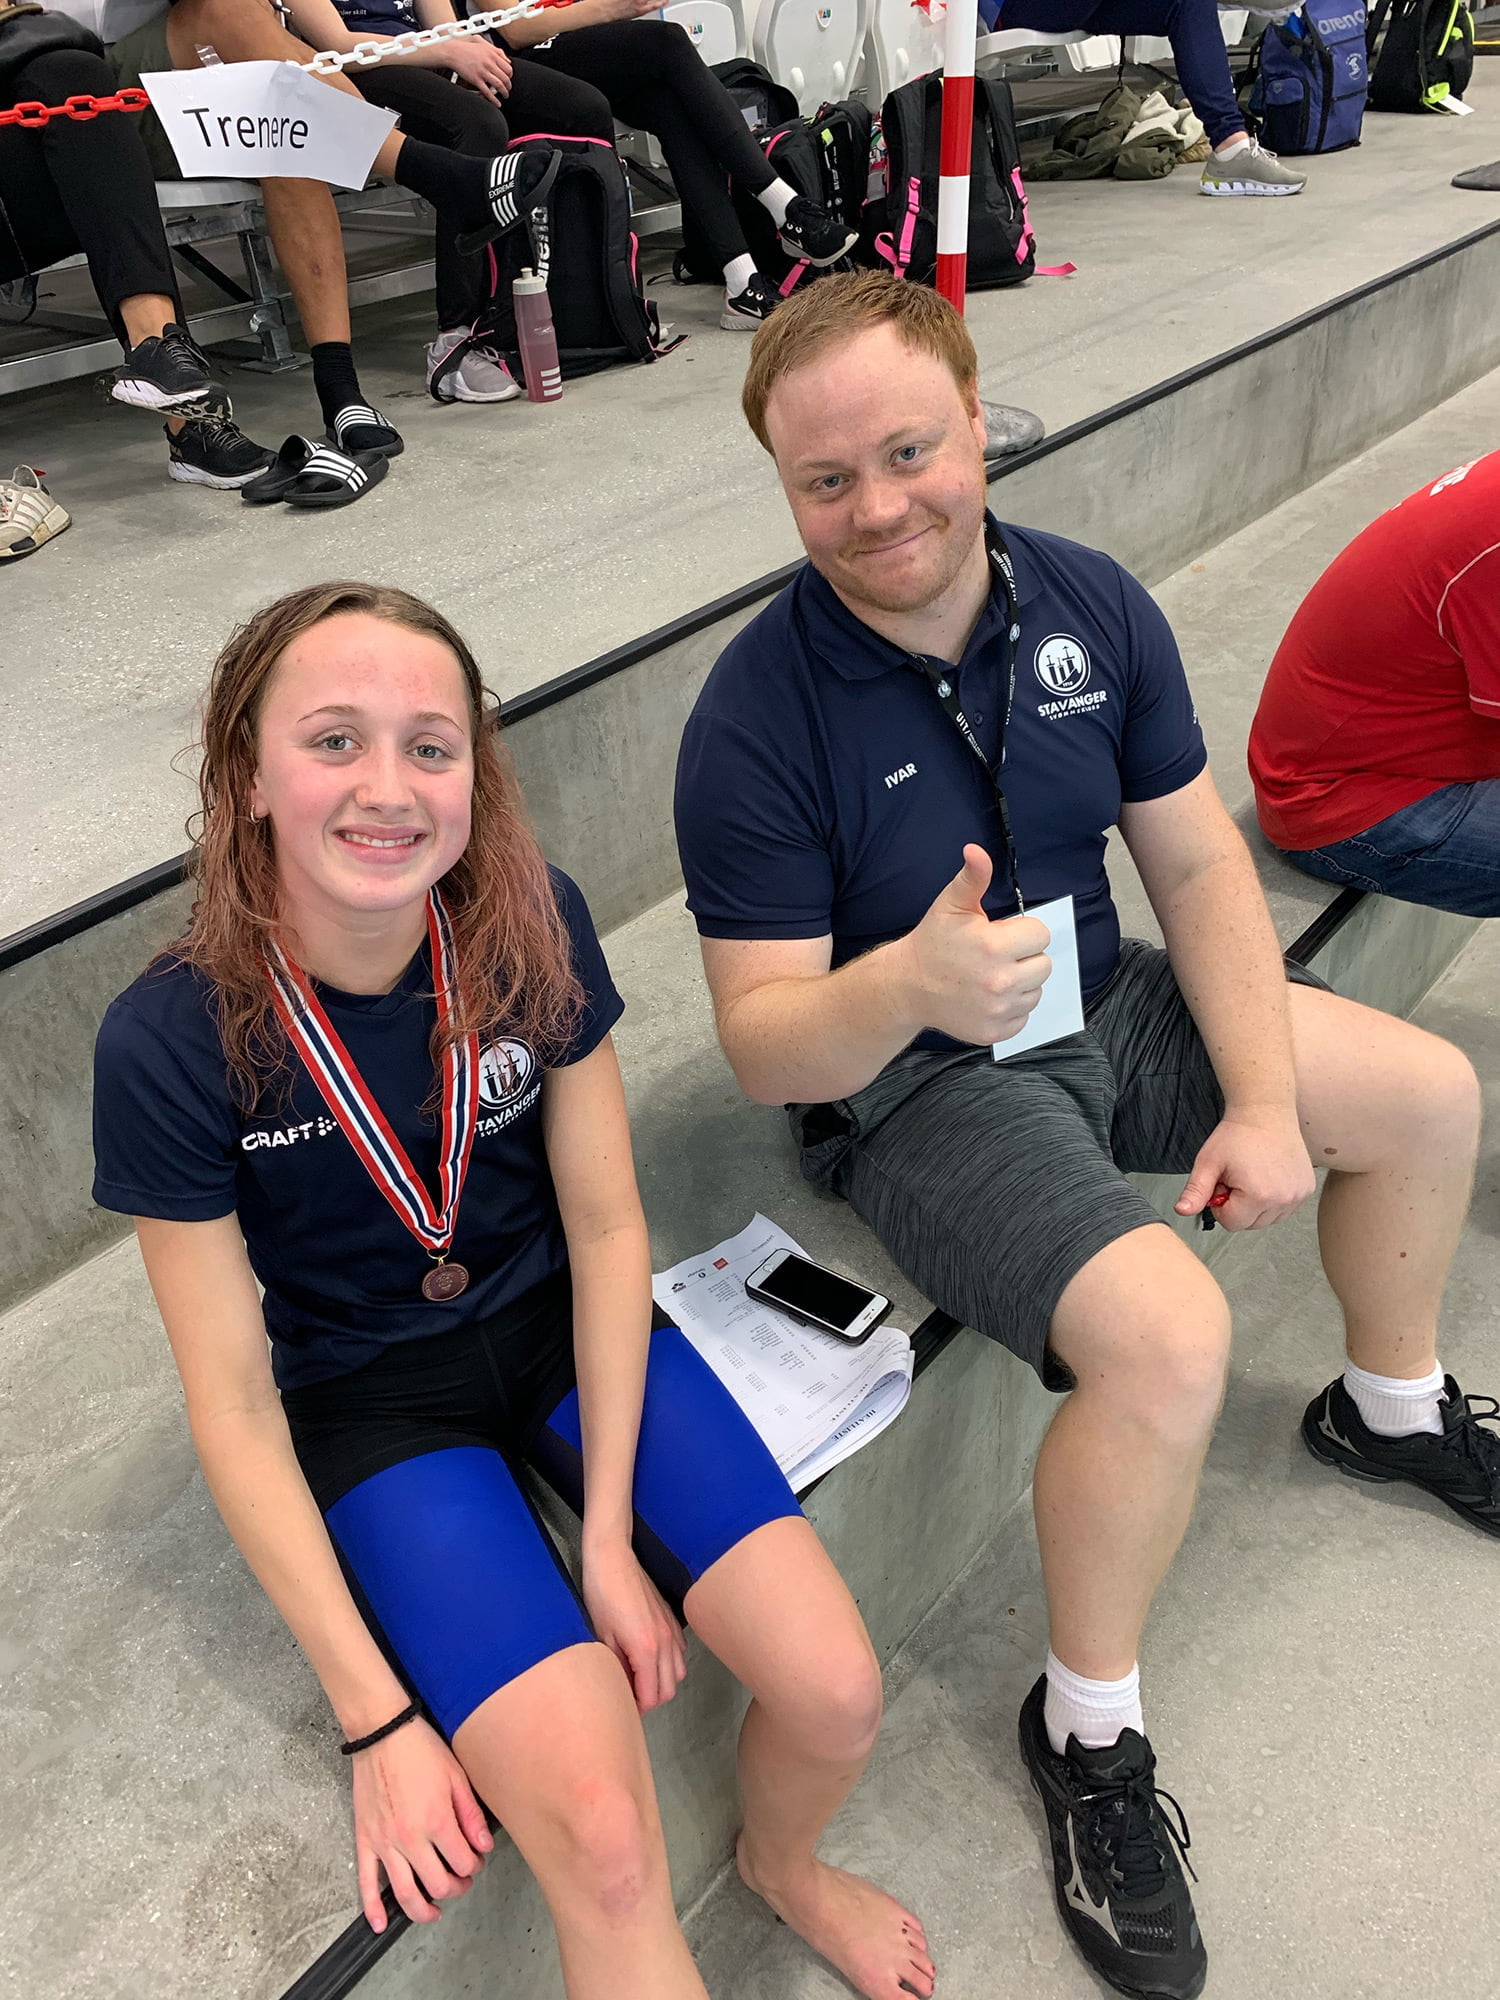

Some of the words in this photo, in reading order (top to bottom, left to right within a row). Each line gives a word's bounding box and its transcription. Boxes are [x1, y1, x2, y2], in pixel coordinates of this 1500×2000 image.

[182, 107, 309, 149] Trenere
[1037, 690, 1108, 717] STAVANGER
[884, 763, 918, 789] IVAR
[474, 1082, 541, 1135] TAVANGER
[241, 1121, 314, 1151] CRAFT
